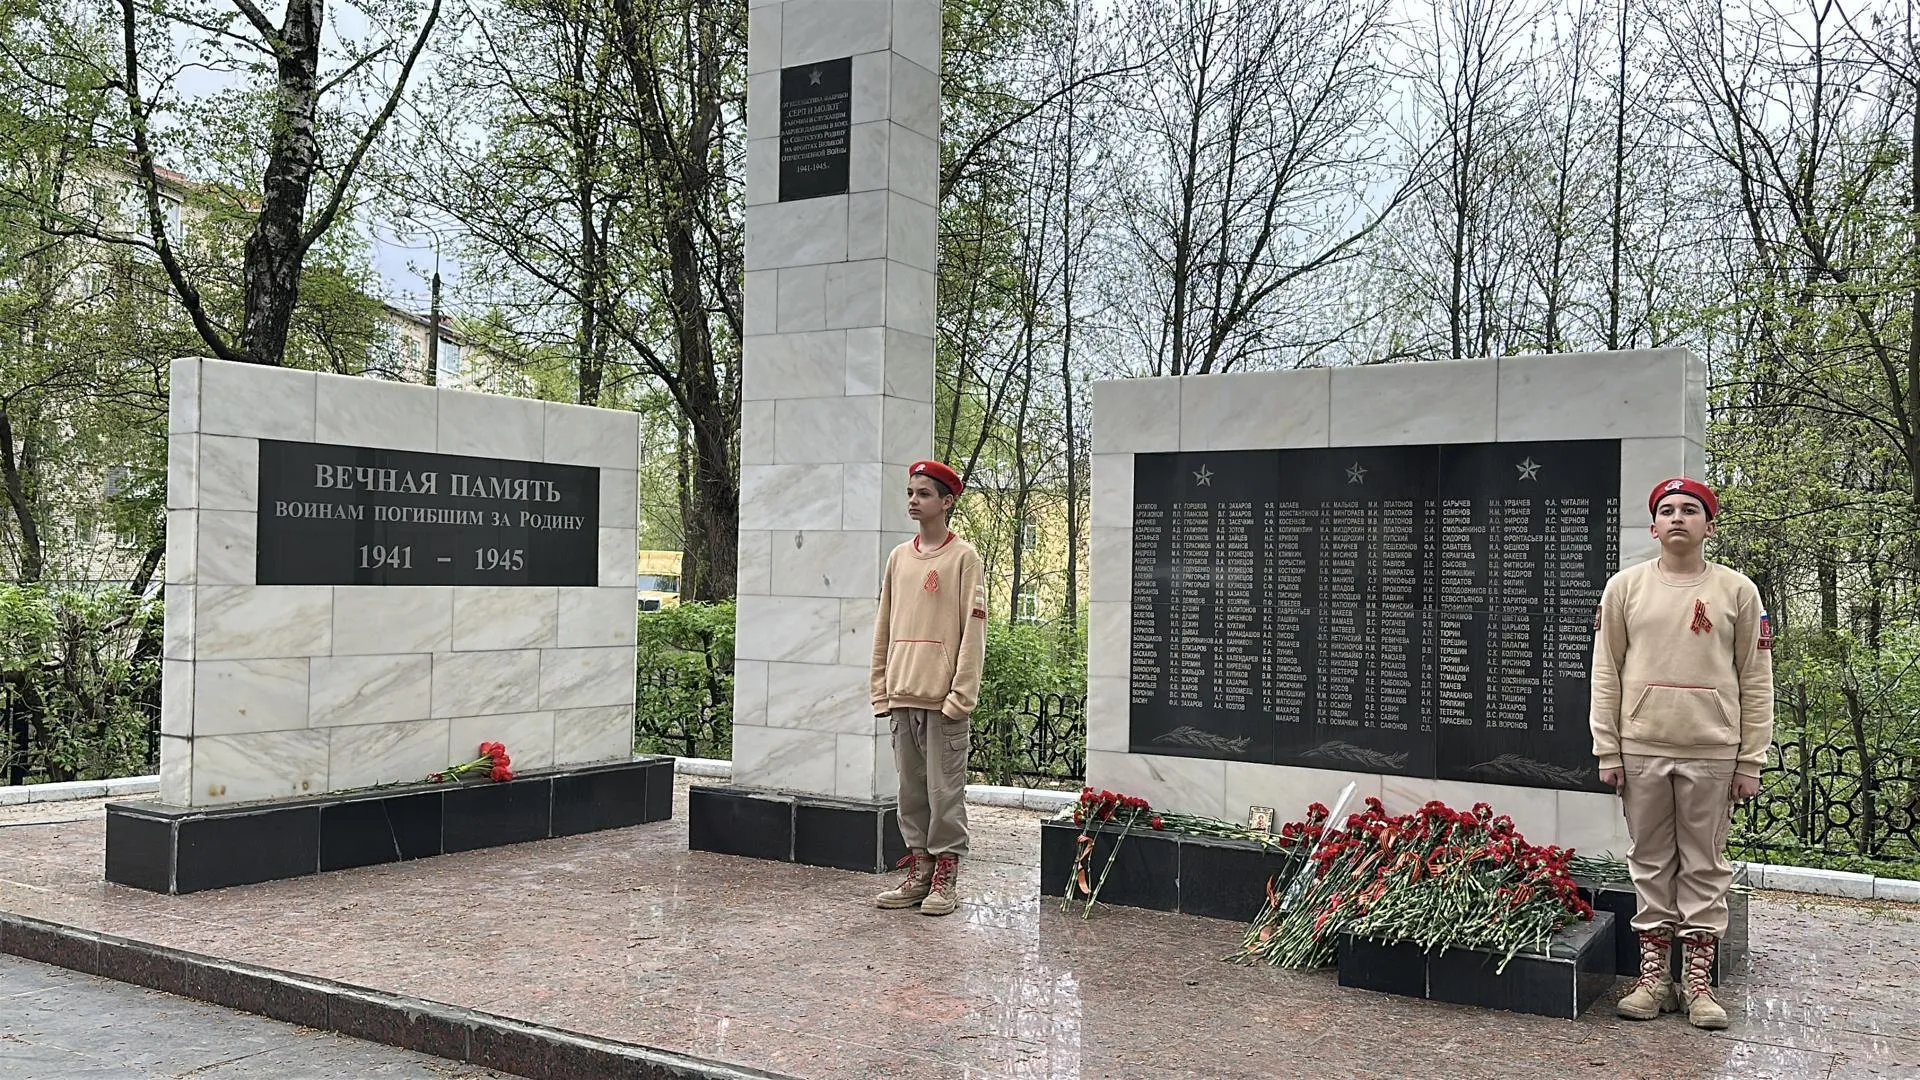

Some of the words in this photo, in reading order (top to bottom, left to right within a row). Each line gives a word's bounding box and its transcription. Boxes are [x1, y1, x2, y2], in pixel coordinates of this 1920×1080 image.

[314, 463, 438, 495] ВЕЧНАЯ
[449, 473, 562, 503] ПАМЯТЬ
[275, 500, 364, 521] ВОИНАМ
[374, 506, 484, 526] ПОГИБШИМ
[491, 512, 511, 527] ЗА
[359, 544, 412, 569] 1941
[474, 547, 524, 571] 1945
